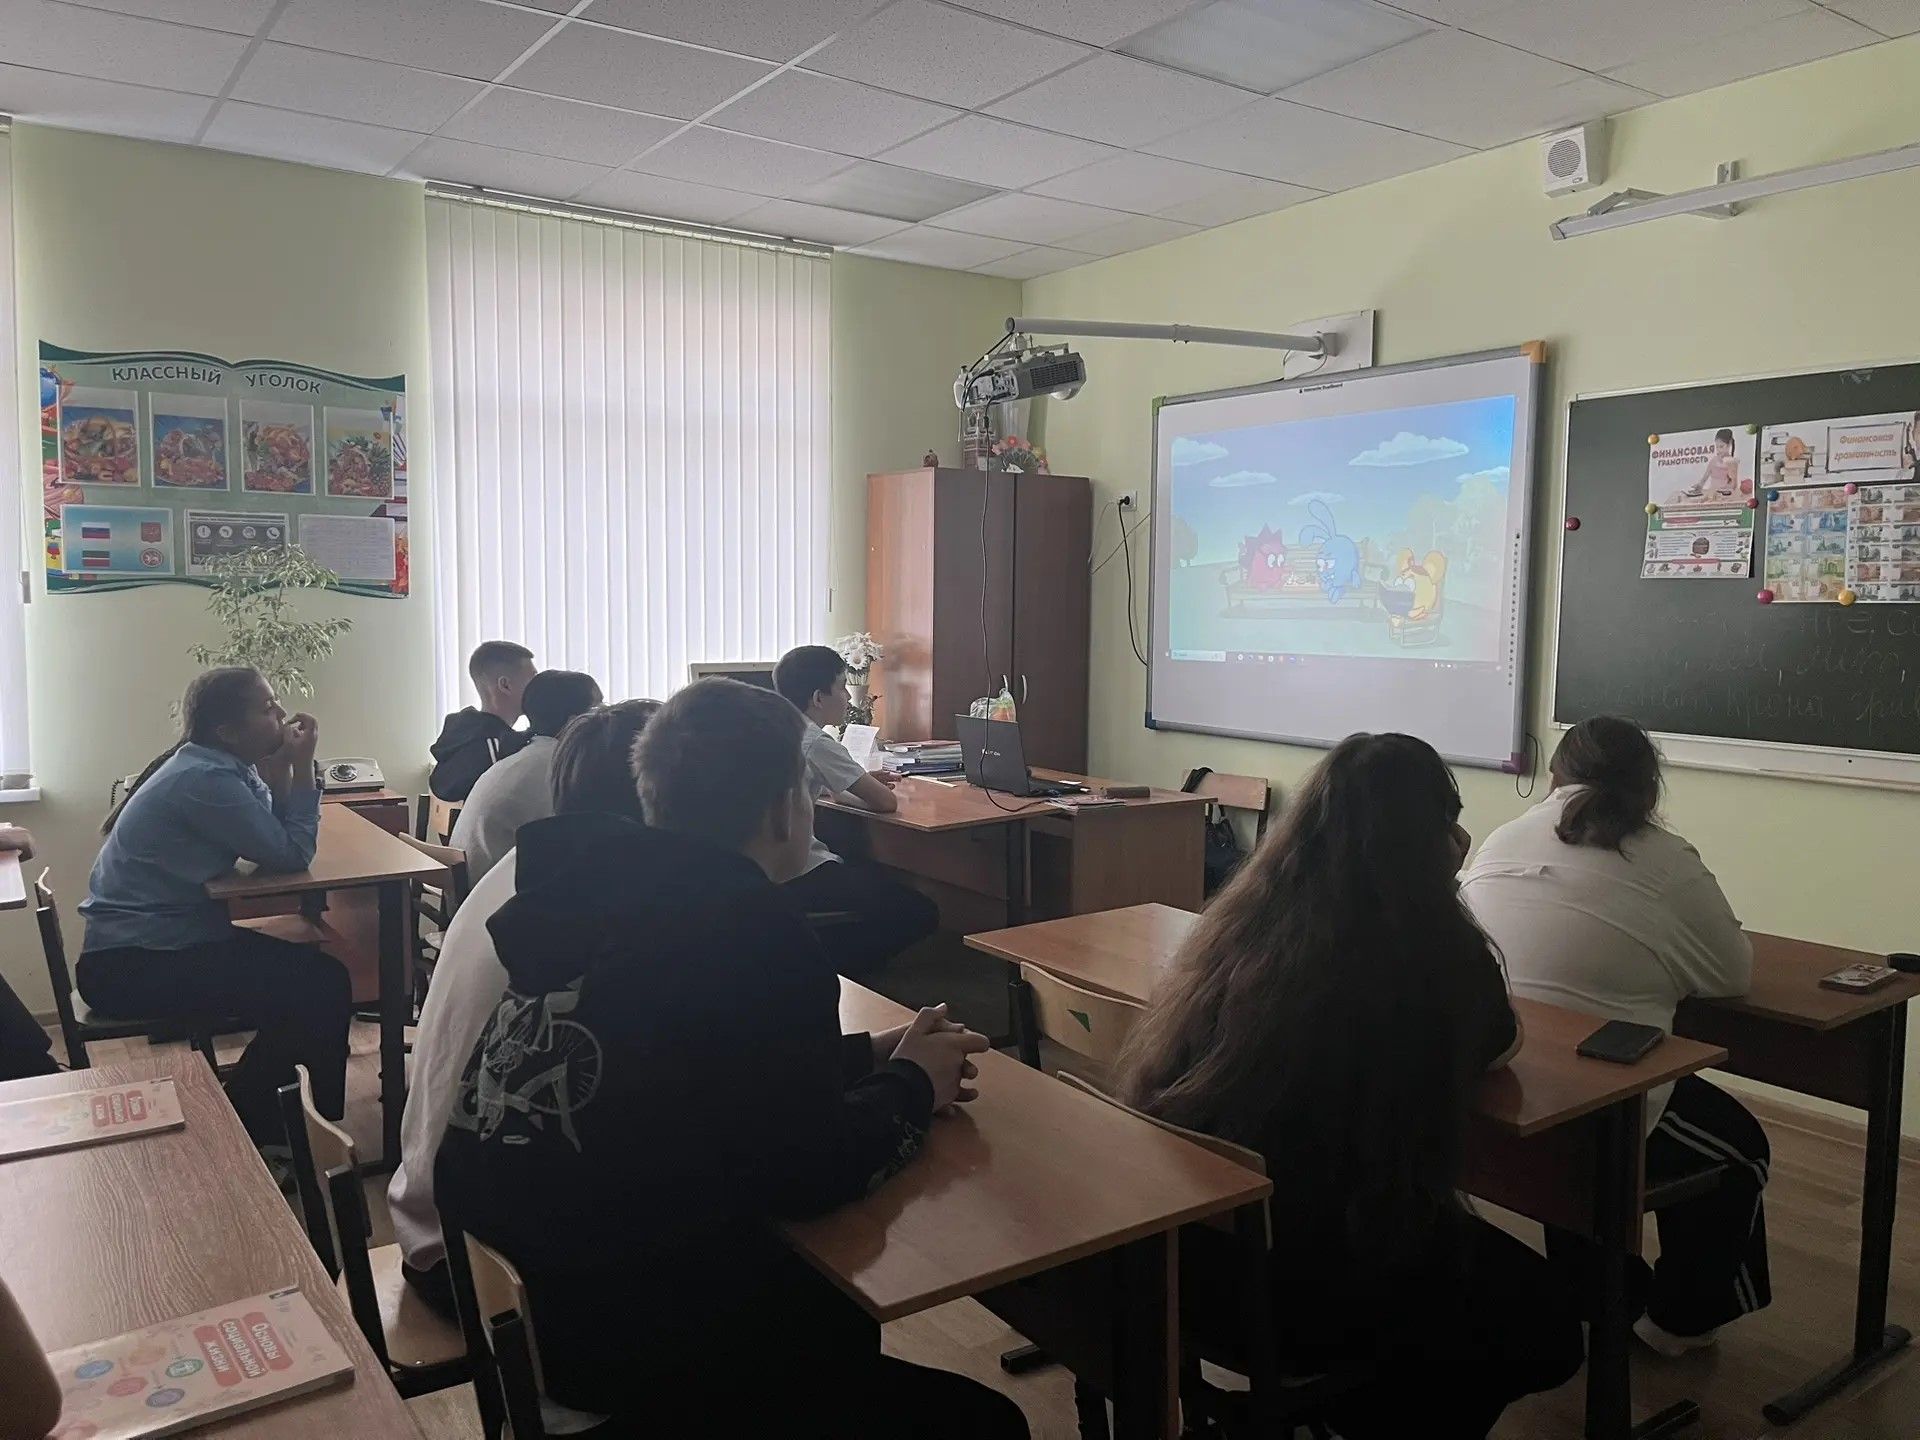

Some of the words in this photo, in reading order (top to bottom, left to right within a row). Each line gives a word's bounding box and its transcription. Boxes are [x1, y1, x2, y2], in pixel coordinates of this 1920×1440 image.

[112, 366, 222, 385] КЛАССНЫЙ
[245, 373, 322, 394] УГОЛОК
[1651, 444, 1715, 459] ФИНАНСОВАЯ
[222, 1320, 266, 1378] социальной
[251, 1322, 280, 1360] Основы
